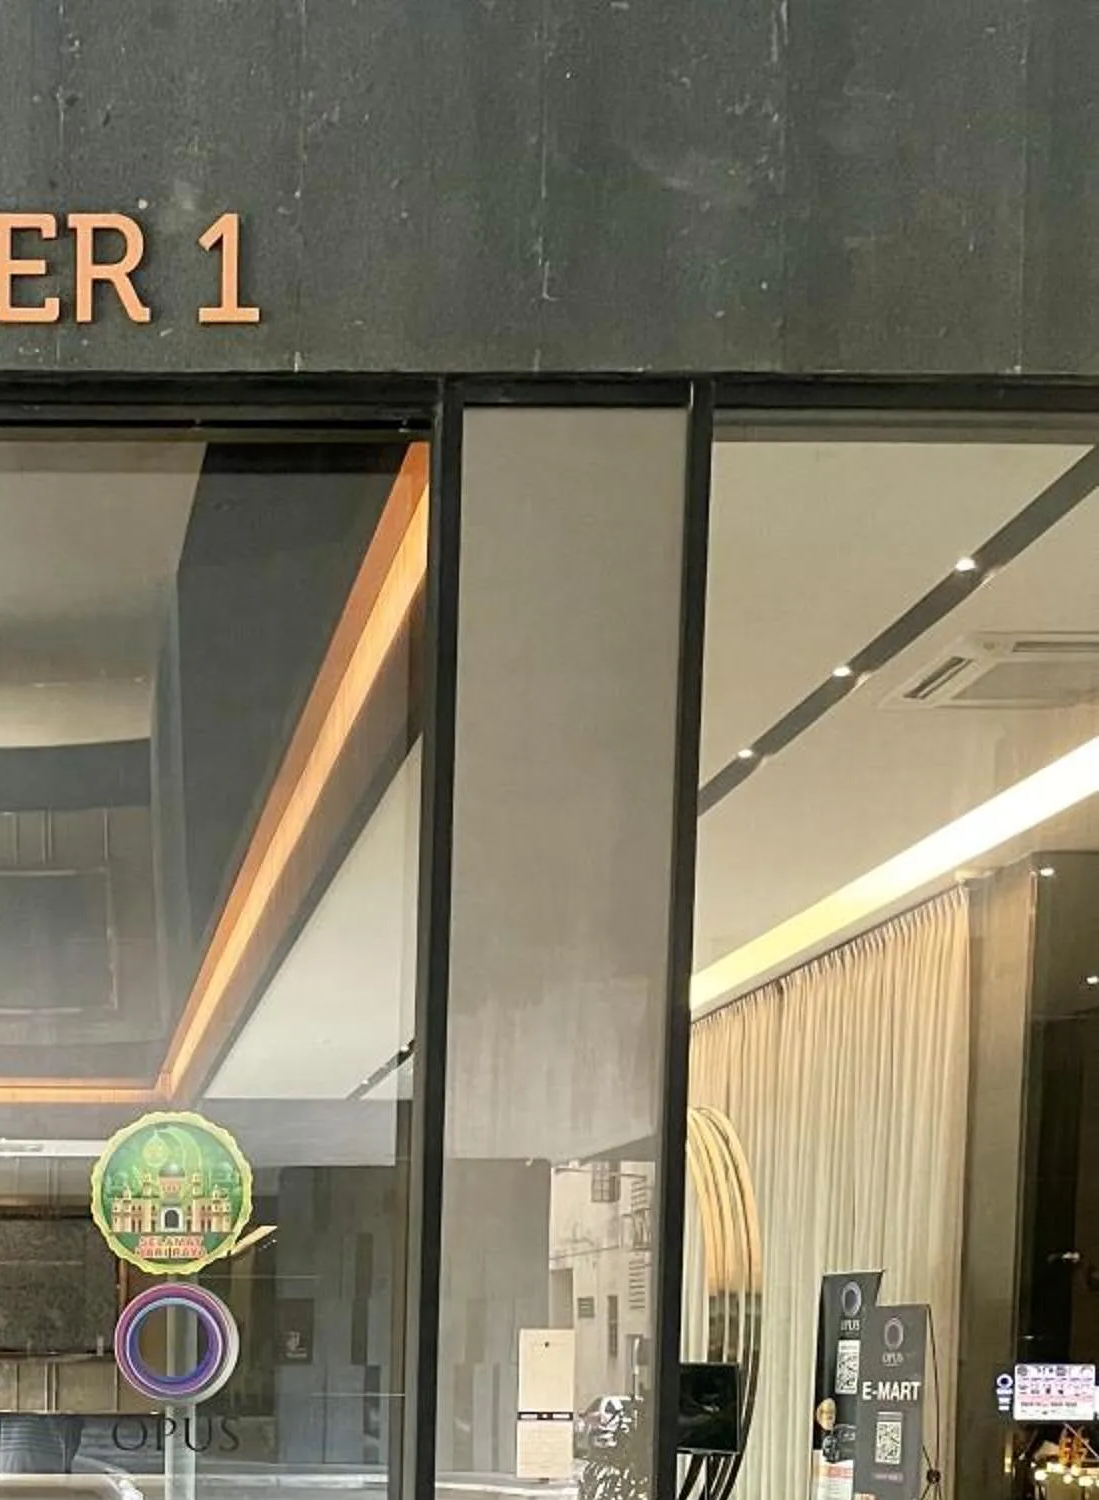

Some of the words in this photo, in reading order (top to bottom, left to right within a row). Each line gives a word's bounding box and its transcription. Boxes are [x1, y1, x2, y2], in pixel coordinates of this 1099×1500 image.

[198, 212, 260, 322] 1
[862, 1381, 921, 1401] E-MART
[112, 1416, 239, 1452] OPUS
